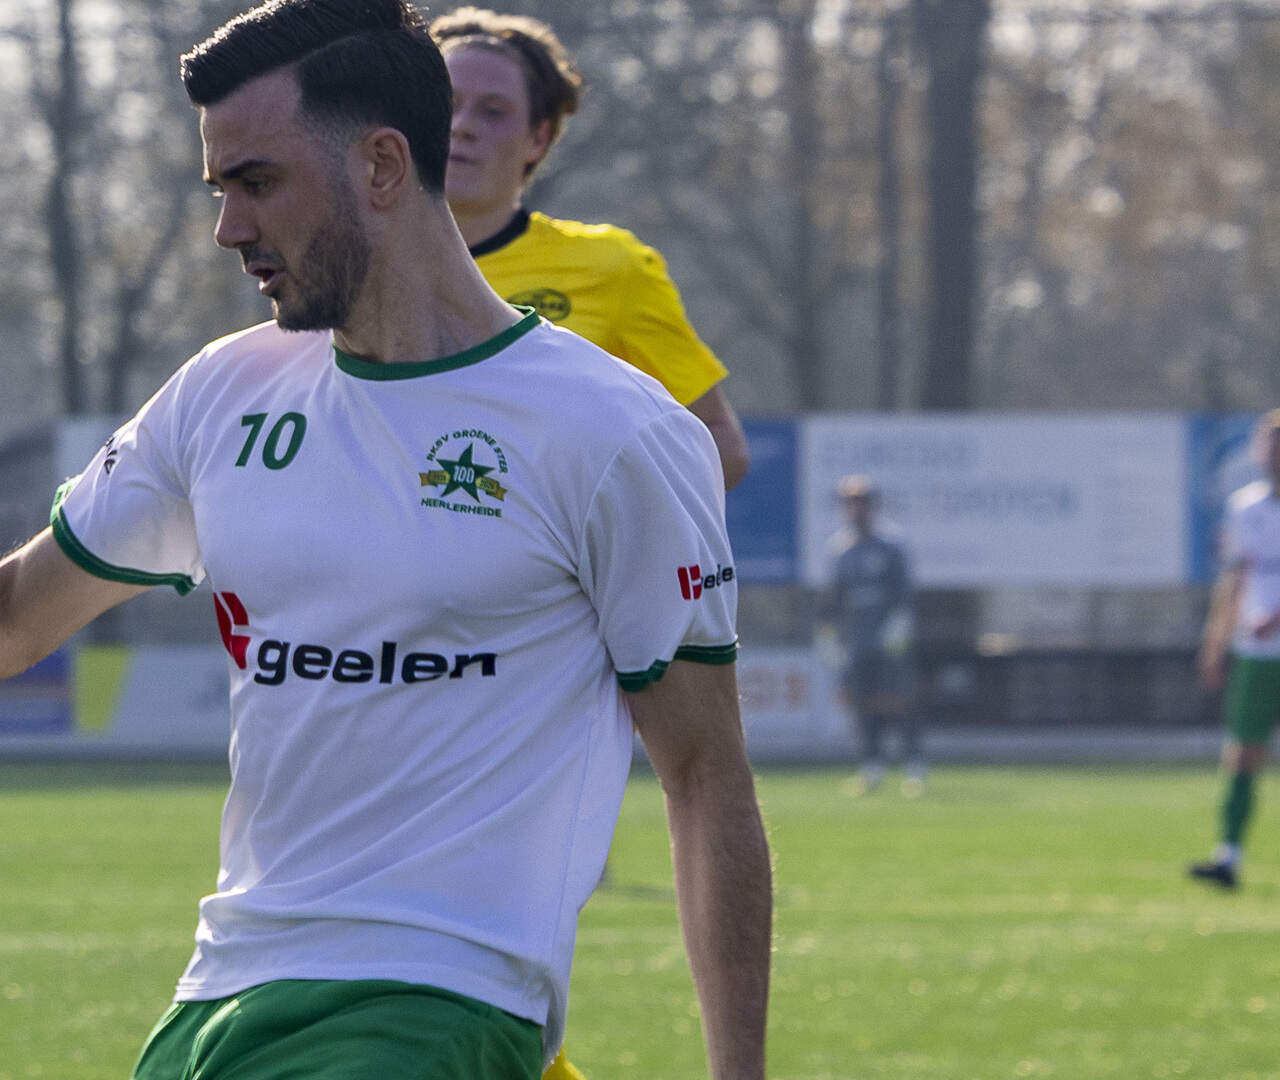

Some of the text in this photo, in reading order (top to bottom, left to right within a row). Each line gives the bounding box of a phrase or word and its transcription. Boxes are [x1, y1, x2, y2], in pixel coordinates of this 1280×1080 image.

[234, 411, 307, 471] 10
[421, 497, 502, 518] HEERLERHEIDE
[254, 639, 497, 686] geelen
